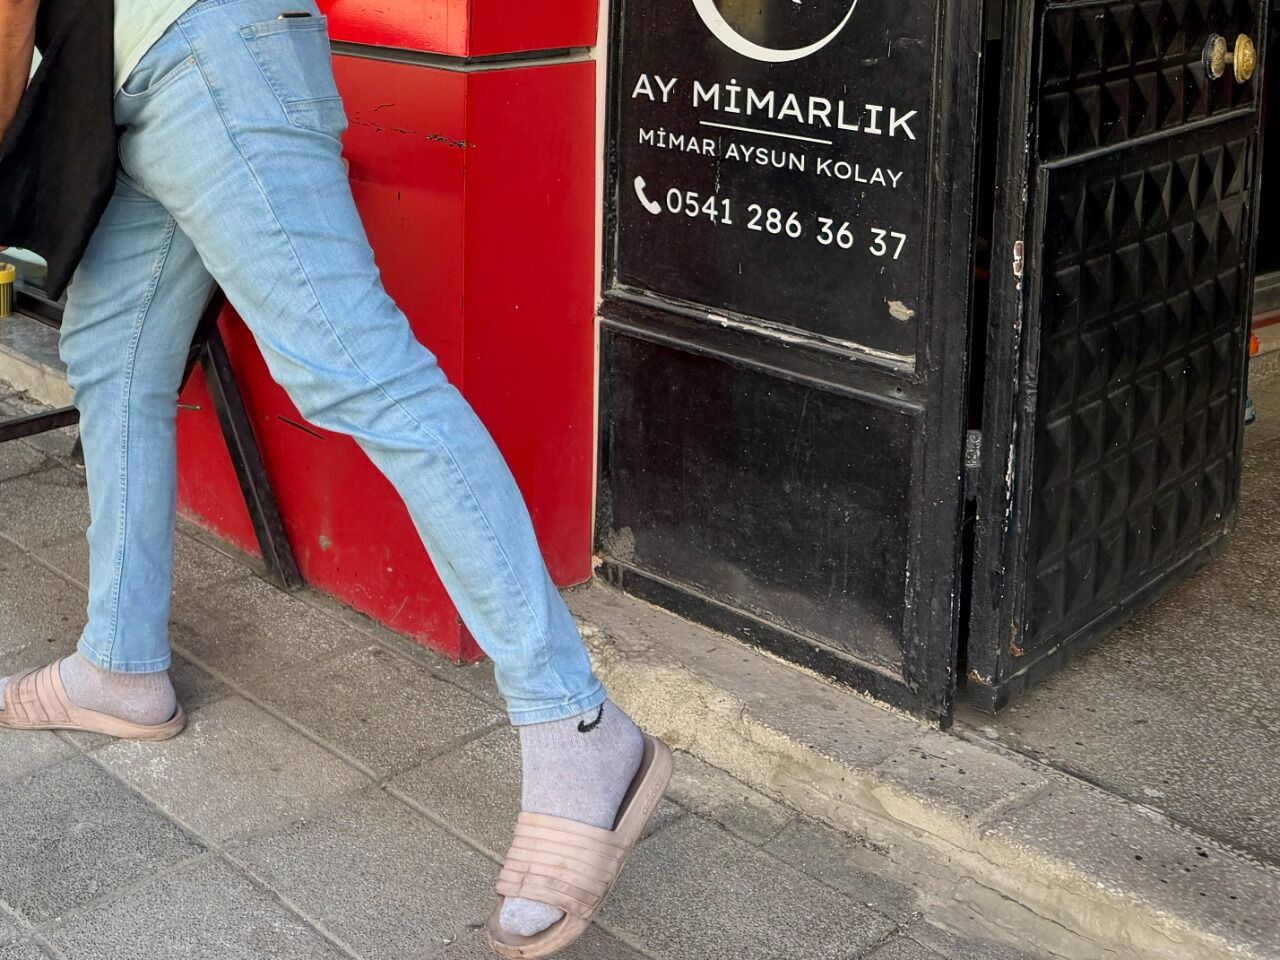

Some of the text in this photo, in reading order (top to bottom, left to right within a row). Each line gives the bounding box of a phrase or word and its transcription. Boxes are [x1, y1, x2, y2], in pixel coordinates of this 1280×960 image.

[632, 74, 918, 140] AY MİMARLIK
[638, 127, 903, 188] MİMAR AYSUN KOLAY
[666, 188, 907, 259] 0541 286 36 37
